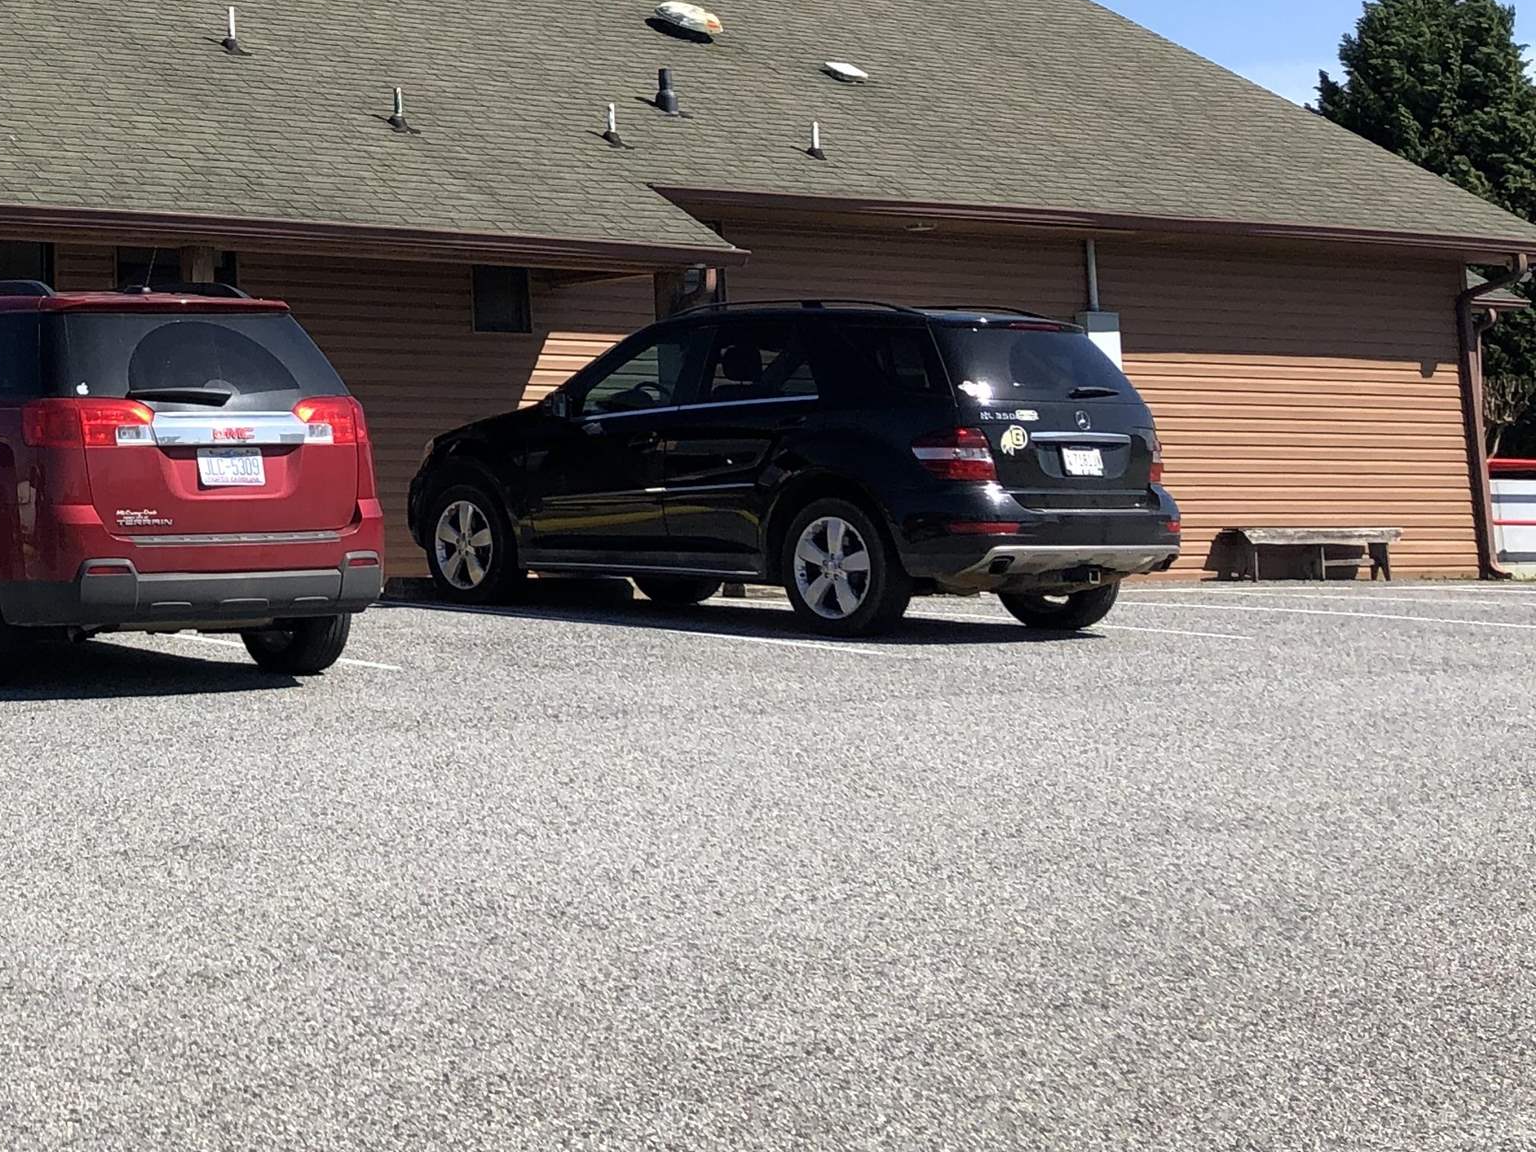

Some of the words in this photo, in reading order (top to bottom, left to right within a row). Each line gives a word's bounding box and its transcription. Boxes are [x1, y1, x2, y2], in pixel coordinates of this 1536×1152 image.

[212, 427, 255, 441] GMC
[204, 457, 261, 477] JLC-5309
[116, 518, 174, 527] TERRAIN
